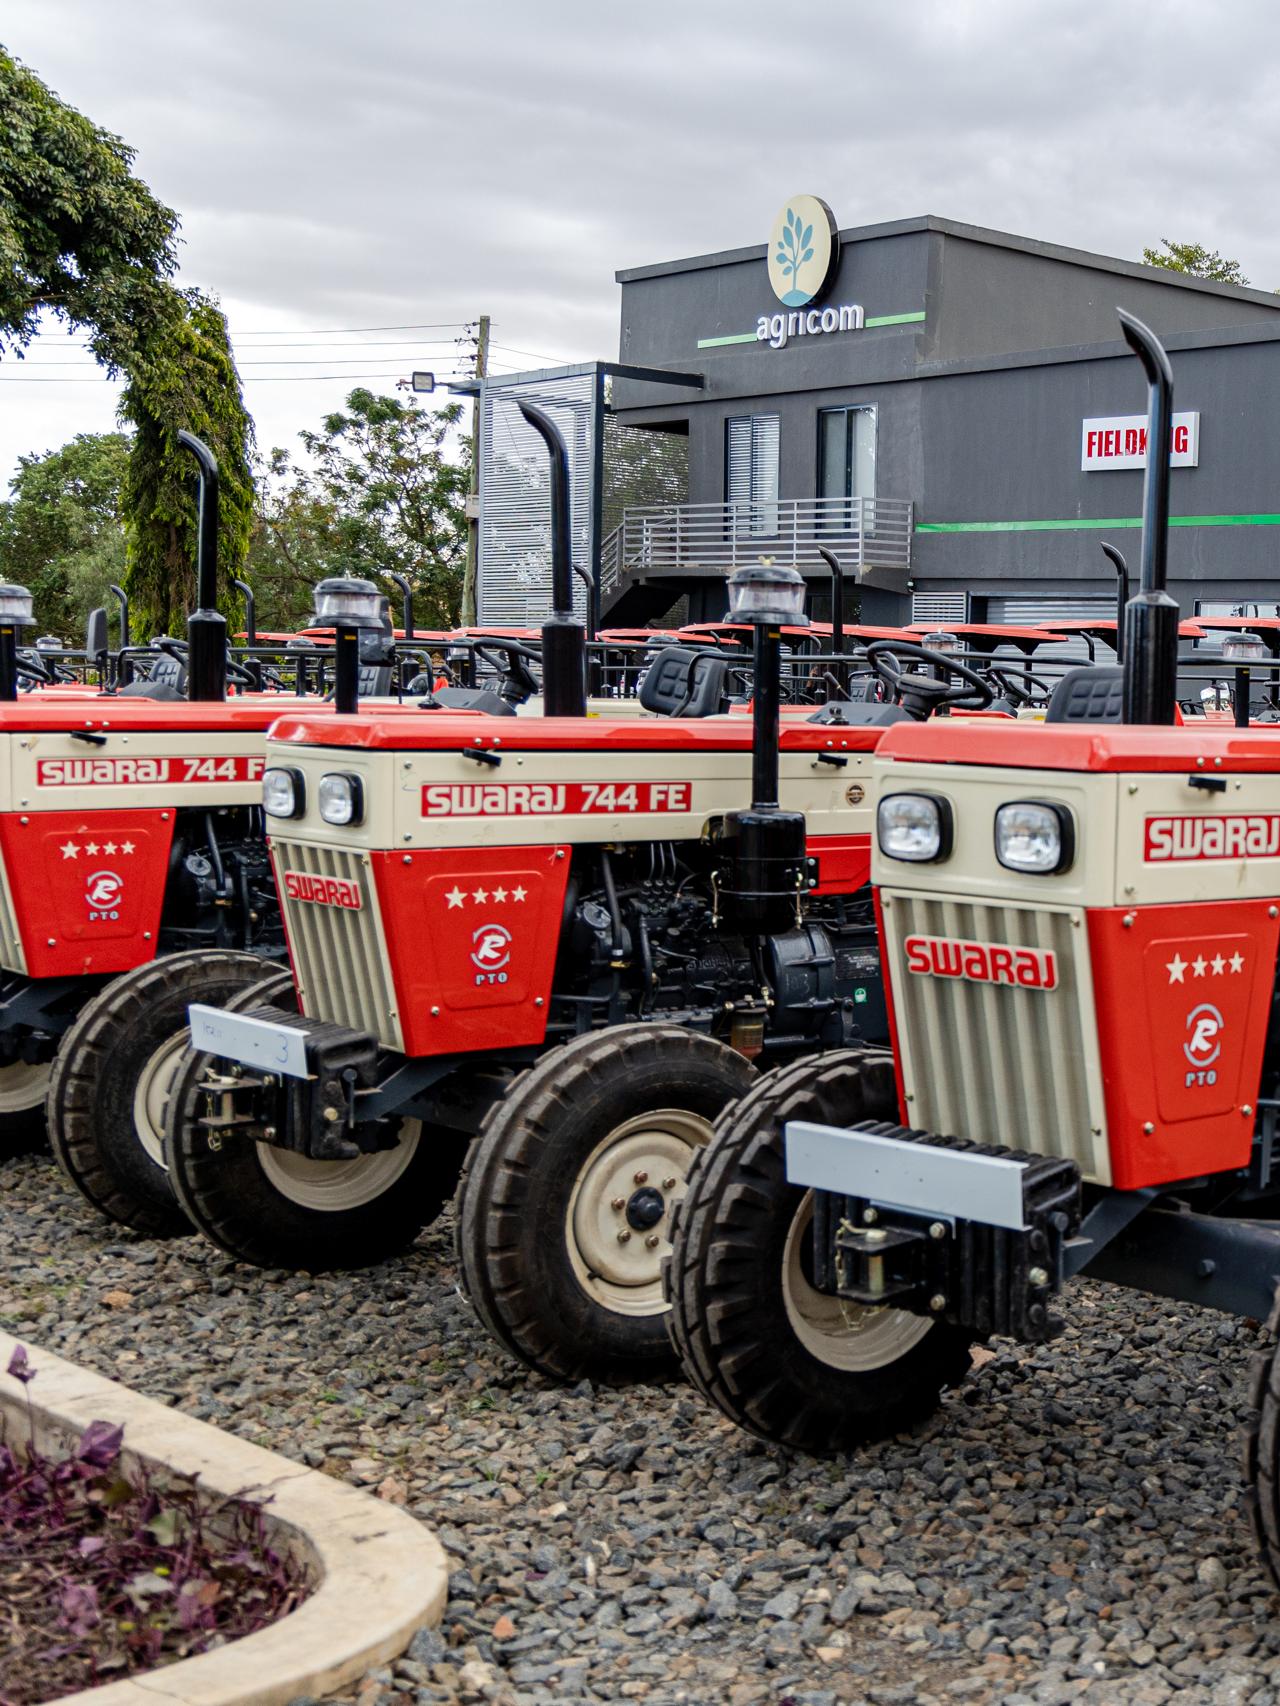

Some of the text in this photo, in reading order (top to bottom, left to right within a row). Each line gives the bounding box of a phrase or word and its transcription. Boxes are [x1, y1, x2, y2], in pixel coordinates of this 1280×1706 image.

[757, 305, 865, 348] agricom
[1087, 425, 1189, 458] FIELDKG
[183, 758, 237, 781] 744
[247, 758, 265, 780] F
[580, 784, 638, 812] 744
[649, 784, 688, 810] FE
[89, 910, 119, 921] PTO
[475, 972, 508, 986] PTO
[1185, 1070, 1217, 1088] PTO
